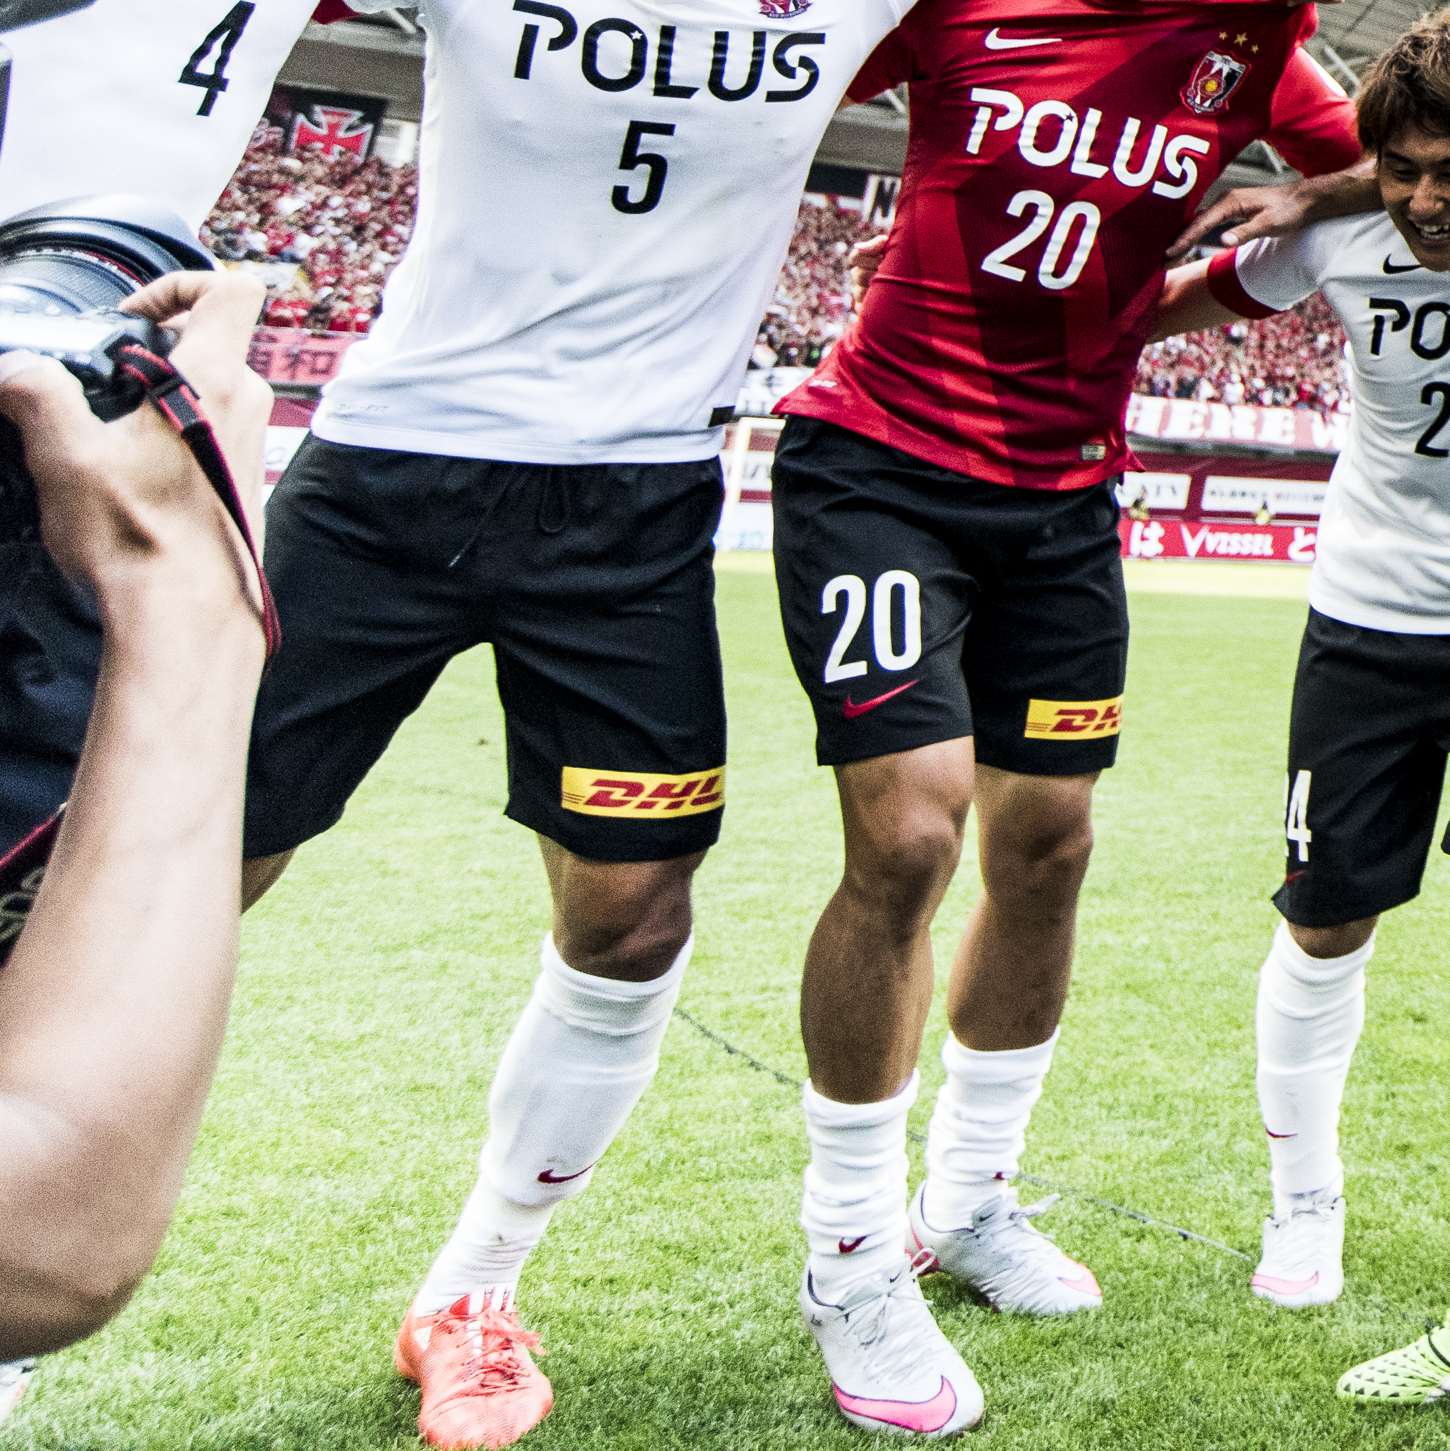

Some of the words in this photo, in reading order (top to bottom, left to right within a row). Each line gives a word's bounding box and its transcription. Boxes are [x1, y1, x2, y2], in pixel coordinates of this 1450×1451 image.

[177, 0, 257, 117] 4
[611, 120, 677, 214] 5
[966, 87, 1211, 199] POLUS
[981, 189, 1101, 291] 20
[820, 569, 922, 684] 20
[1050, 703, 1122, 733] DH
[584, 774, 723, 810] DHL
[1284, 769, 1312, 863] 4
